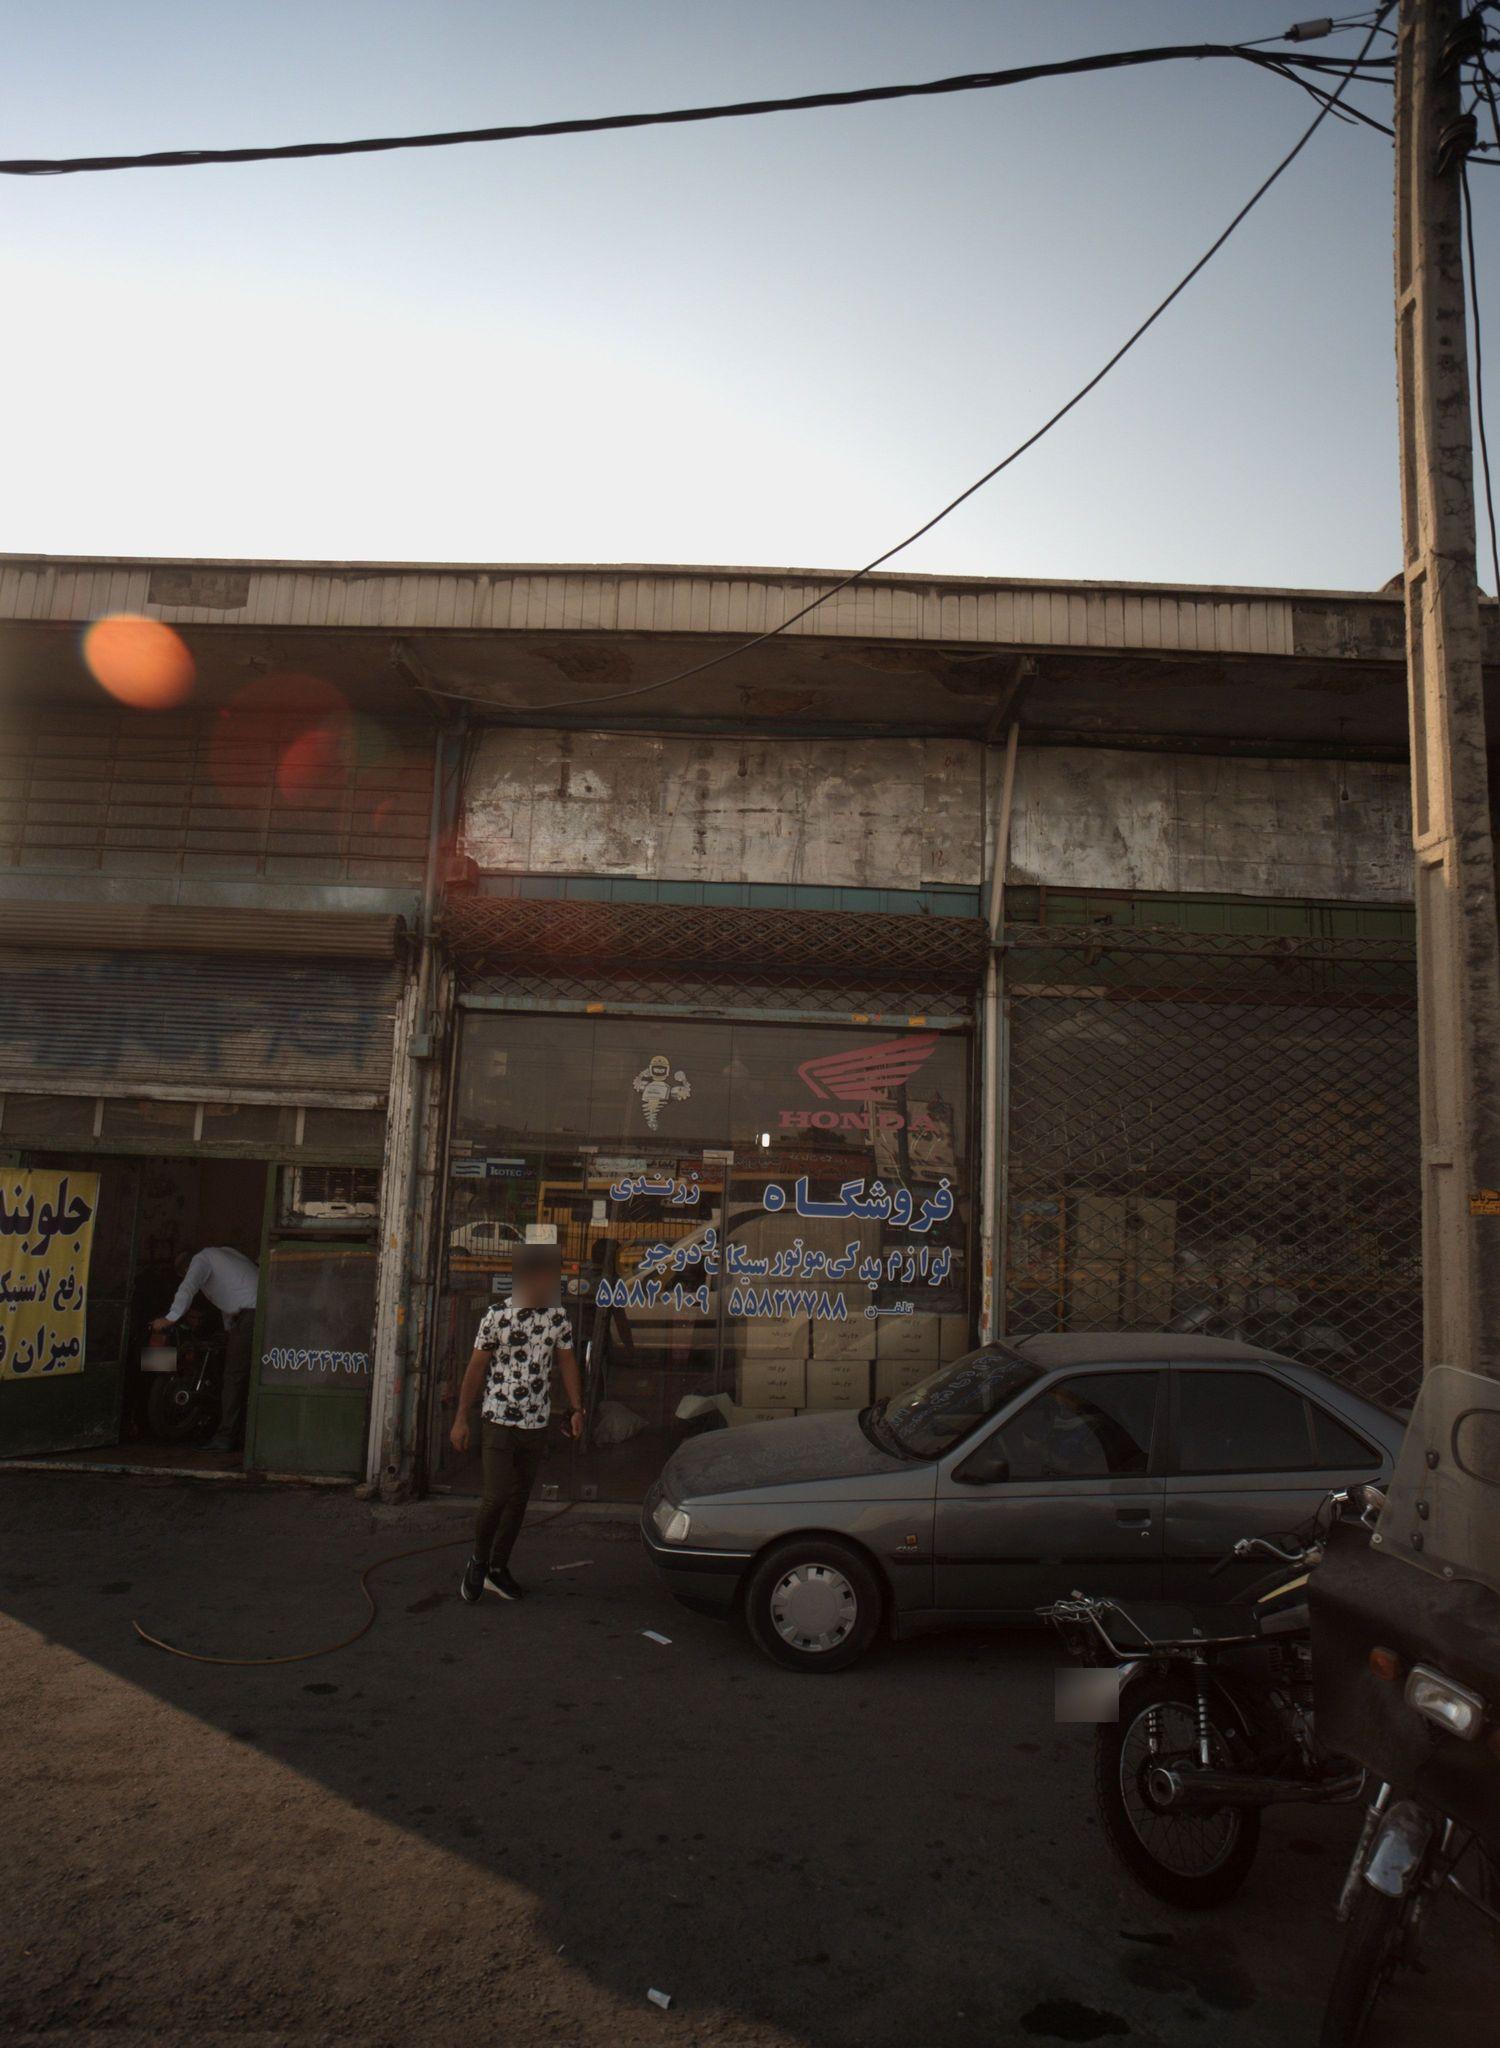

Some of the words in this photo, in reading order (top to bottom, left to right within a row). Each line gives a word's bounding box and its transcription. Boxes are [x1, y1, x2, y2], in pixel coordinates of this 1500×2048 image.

[778, 1110, 941, 1132] HONDA
[609, 1171, 701, 1205] زرندی
[762, 1175, 955, 1232] فروشگاه
[825, 1240, 883, 1290] یدکی
[887, 1245, 952, 1286] لوازم
[53, 1266, 84, 1312] رفع
[863, 1301, 916, 1320] تلفن
[12, 1325, 81, 1373] میزان
